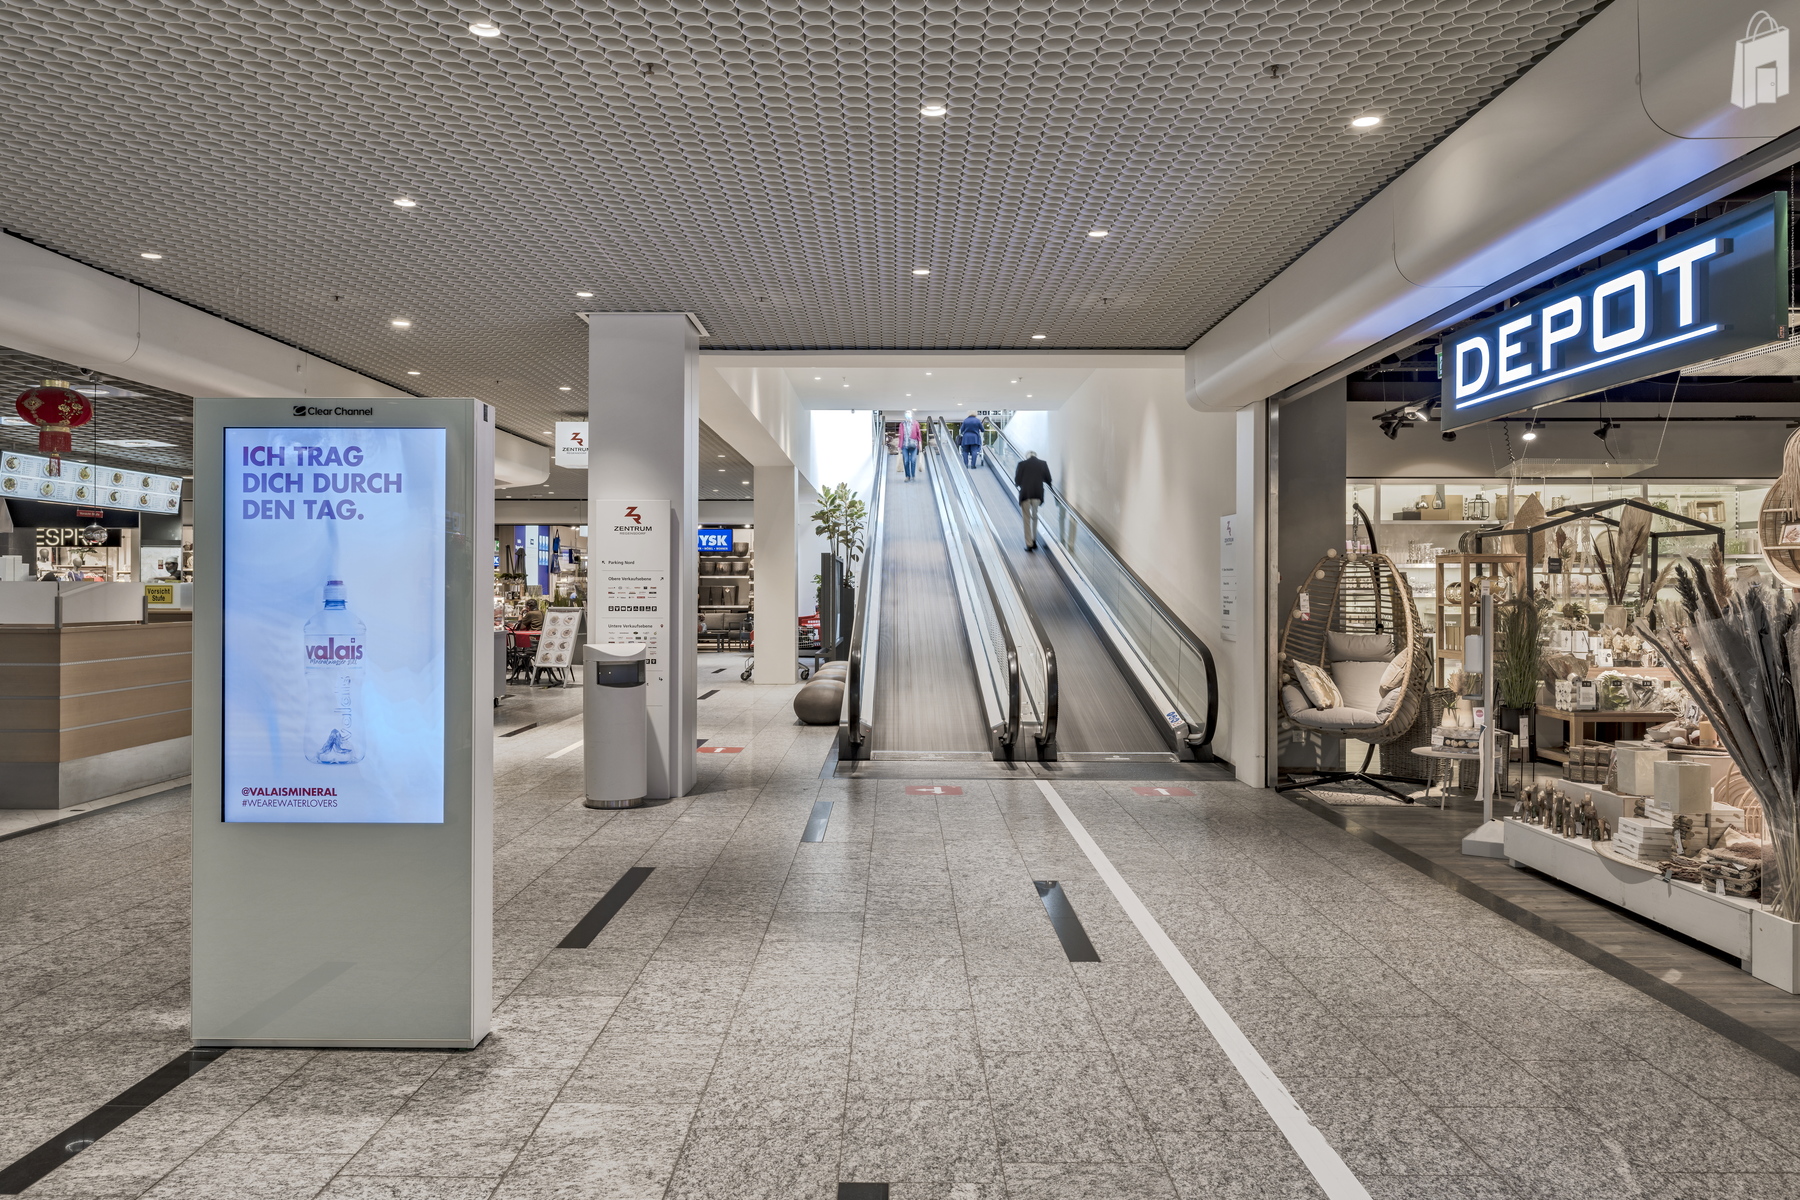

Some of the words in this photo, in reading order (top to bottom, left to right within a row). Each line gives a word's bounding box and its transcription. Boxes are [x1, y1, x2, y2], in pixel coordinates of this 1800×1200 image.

[1455, 237, 1721, 400] DEPOT
[307, 406, 333, 416] Clear
[334, 406, 373, 416] Channel
[242, 445, 286, 467] ICH
[293, 445, 364, 467] TRAG
[242, 472, 304, 493] DICH
[312, 472, 403, 493] DURCH
[242, 499, 295, 520] DEN
[303, 498, 365, 520] TAG.
[36, 528, 107, 546] ESPR
[698, 534, 728, 546] YSK
[147, 587, 171, 595] Vorsicht
[151, 594, 166, 602] Stufe
[305, 637, 363, 660] valais
[241, 787, 338, 797] @VALAISMINERAL
[242, 799, 338, 808] #WEAREWATERLOVERS
